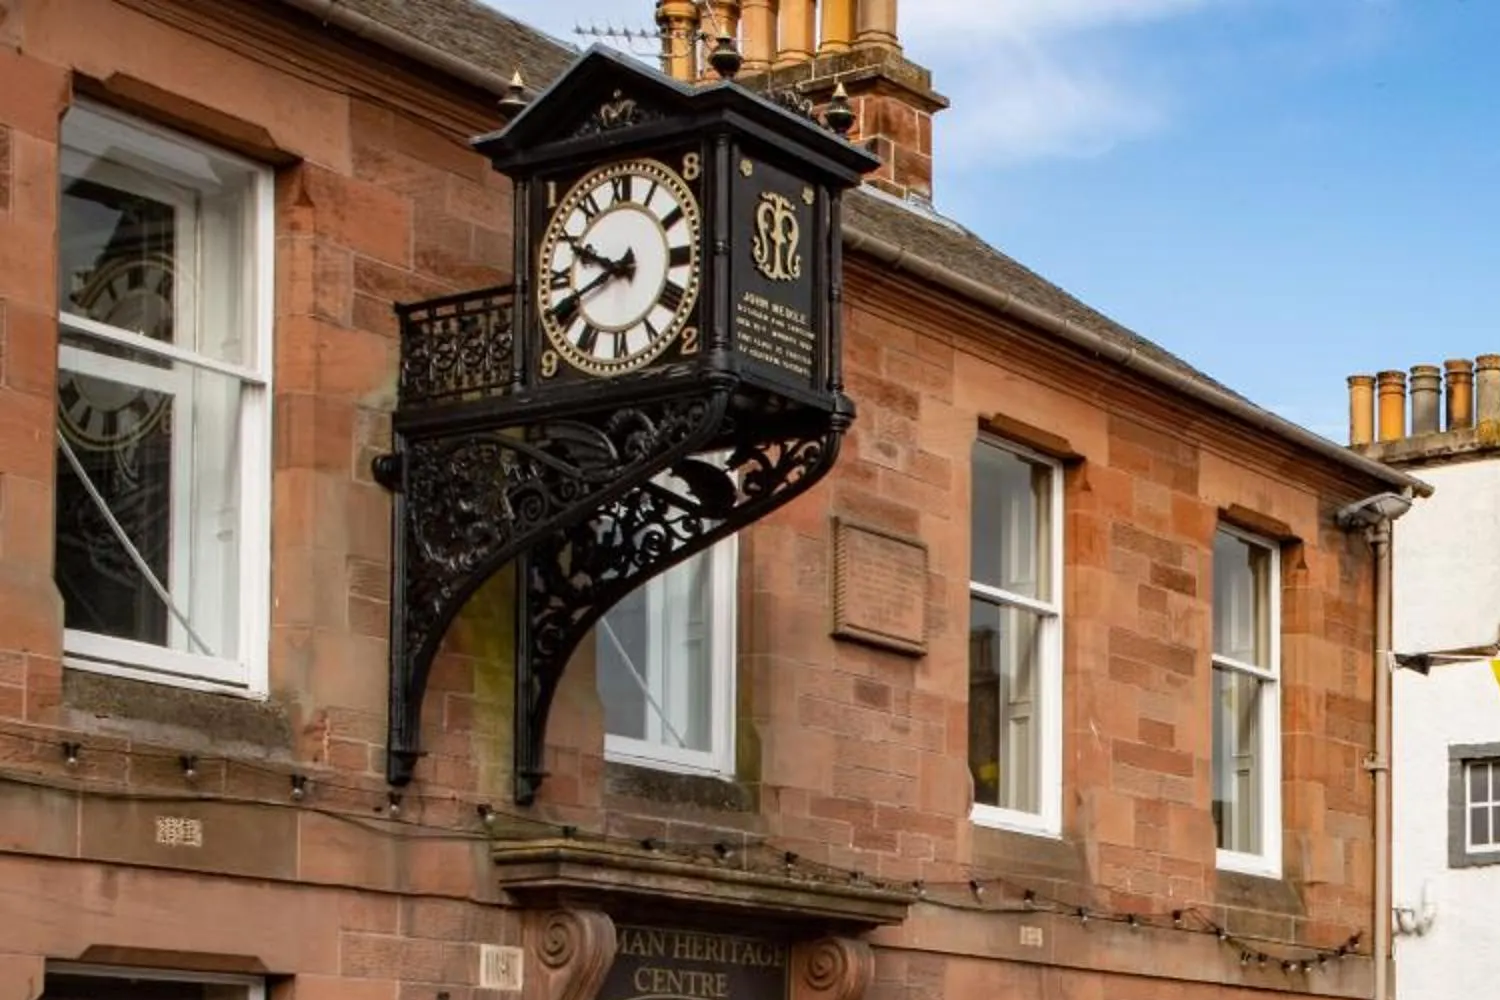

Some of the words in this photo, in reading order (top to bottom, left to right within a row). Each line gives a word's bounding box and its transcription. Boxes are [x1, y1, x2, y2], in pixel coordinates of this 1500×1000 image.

[546, 181, 557, 209] 1
[682, 152, 699, 181] 8
[541, 350, 558, 378] 9
[681, 327, 699, 355] 2
[615, 930, 666, 958] MAN
[673, 932, 787, 968] HERITAGE
[634, 966, 730, 998] CENTRE
